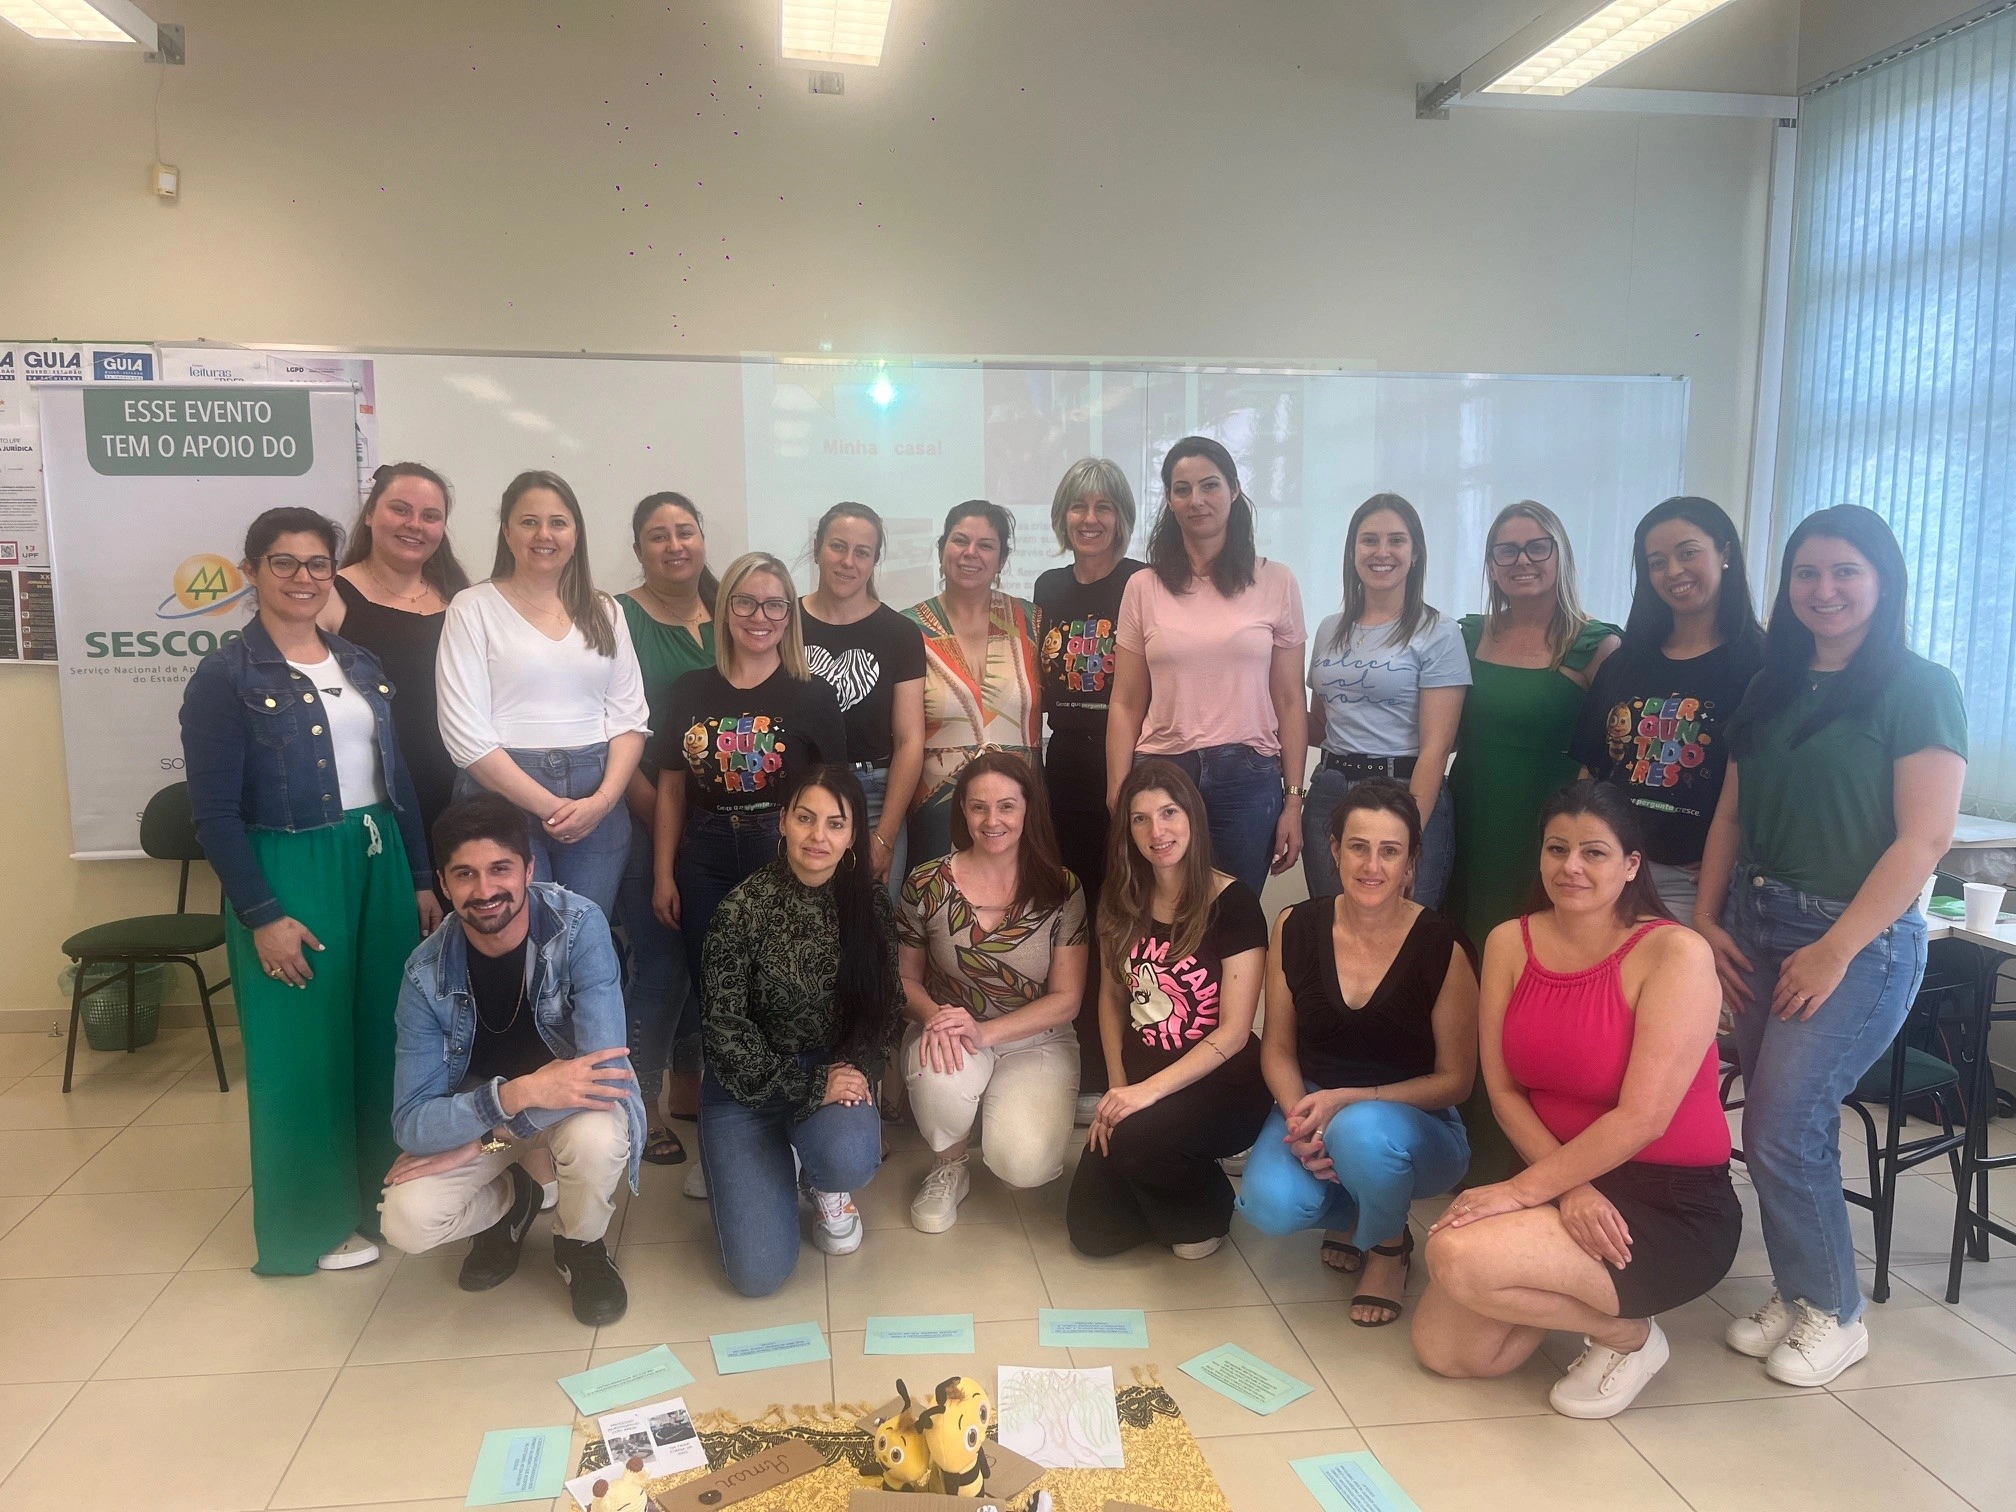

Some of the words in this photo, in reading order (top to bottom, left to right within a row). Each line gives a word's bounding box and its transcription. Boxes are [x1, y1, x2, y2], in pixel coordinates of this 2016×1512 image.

[24, 351, 81, 368] GUIA
[103, 357, 143, 371] GUIA
[189, 366, 232, 377] leituras
[125, 400, 178, 423] ESSE
[185, 400, 272, 423] EVENTO
[102, 435, 150, 457] TEM
[158, 435, 175, 457] O
[182, 435, 254, 458] APOIO
[262, 435, 296, 458] DO
[822, 438, 878, 455] Minha
[894, 439, 943, 456] casa!
[70, 667, 110, 676] Serviço
[114, 665, 161, 674] Nacional
[165, 665, 178, 673] de
[1063, 653, 1116, 674] TADO
[133, 675, 147, 683] do
[150, 674, 186, 683] Estado
[1067, 671, 1105, 692] RES
[715, 750, 782, 773] TADO
[1633, 735, 1706, 768] TADO
[724, 771, 767, 792] RES
[1630, 760, 1681, 787] RES
[1636, 798, 1675, 812] pergunta
[714, 1454, 791, 1489] Amar
